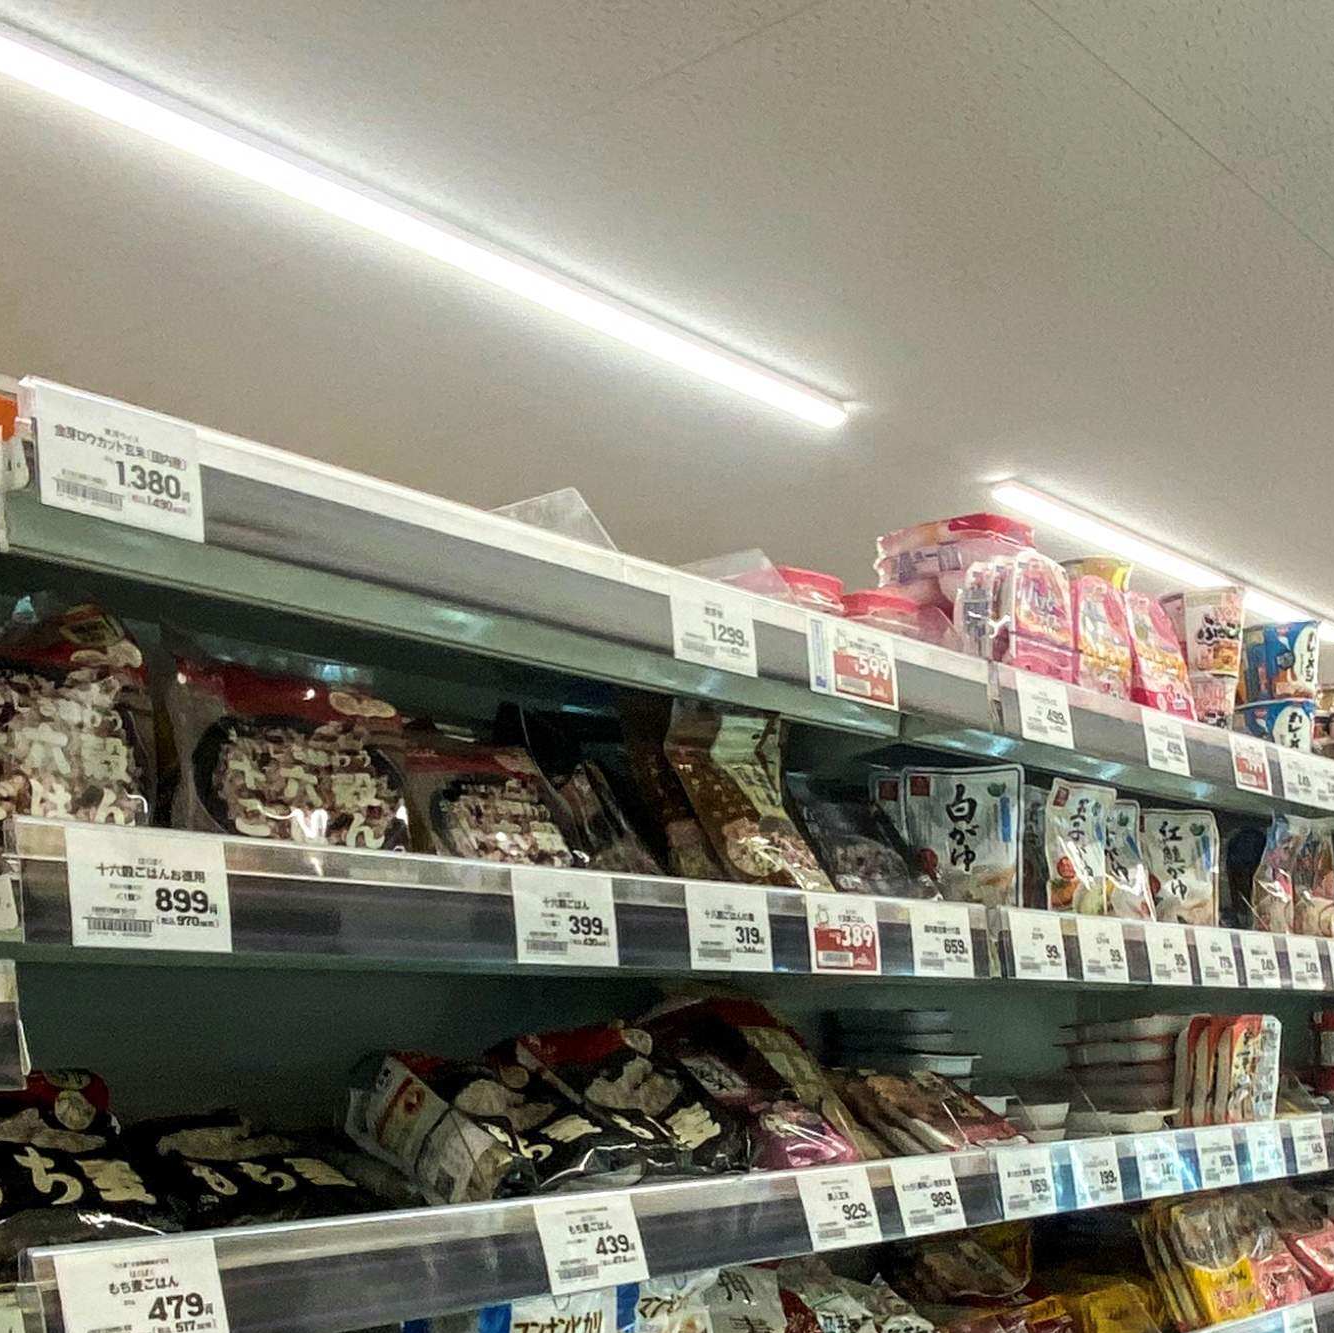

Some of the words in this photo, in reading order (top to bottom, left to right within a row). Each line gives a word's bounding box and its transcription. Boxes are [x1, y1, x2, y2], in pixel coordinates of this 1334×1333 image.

[858, 655, 891, 681] 599
[945, 783, 979, 874] 白がゆ
[840, 924, 874, 947] 389
[108, 1276, 180, 1295] もち麦ごはん
